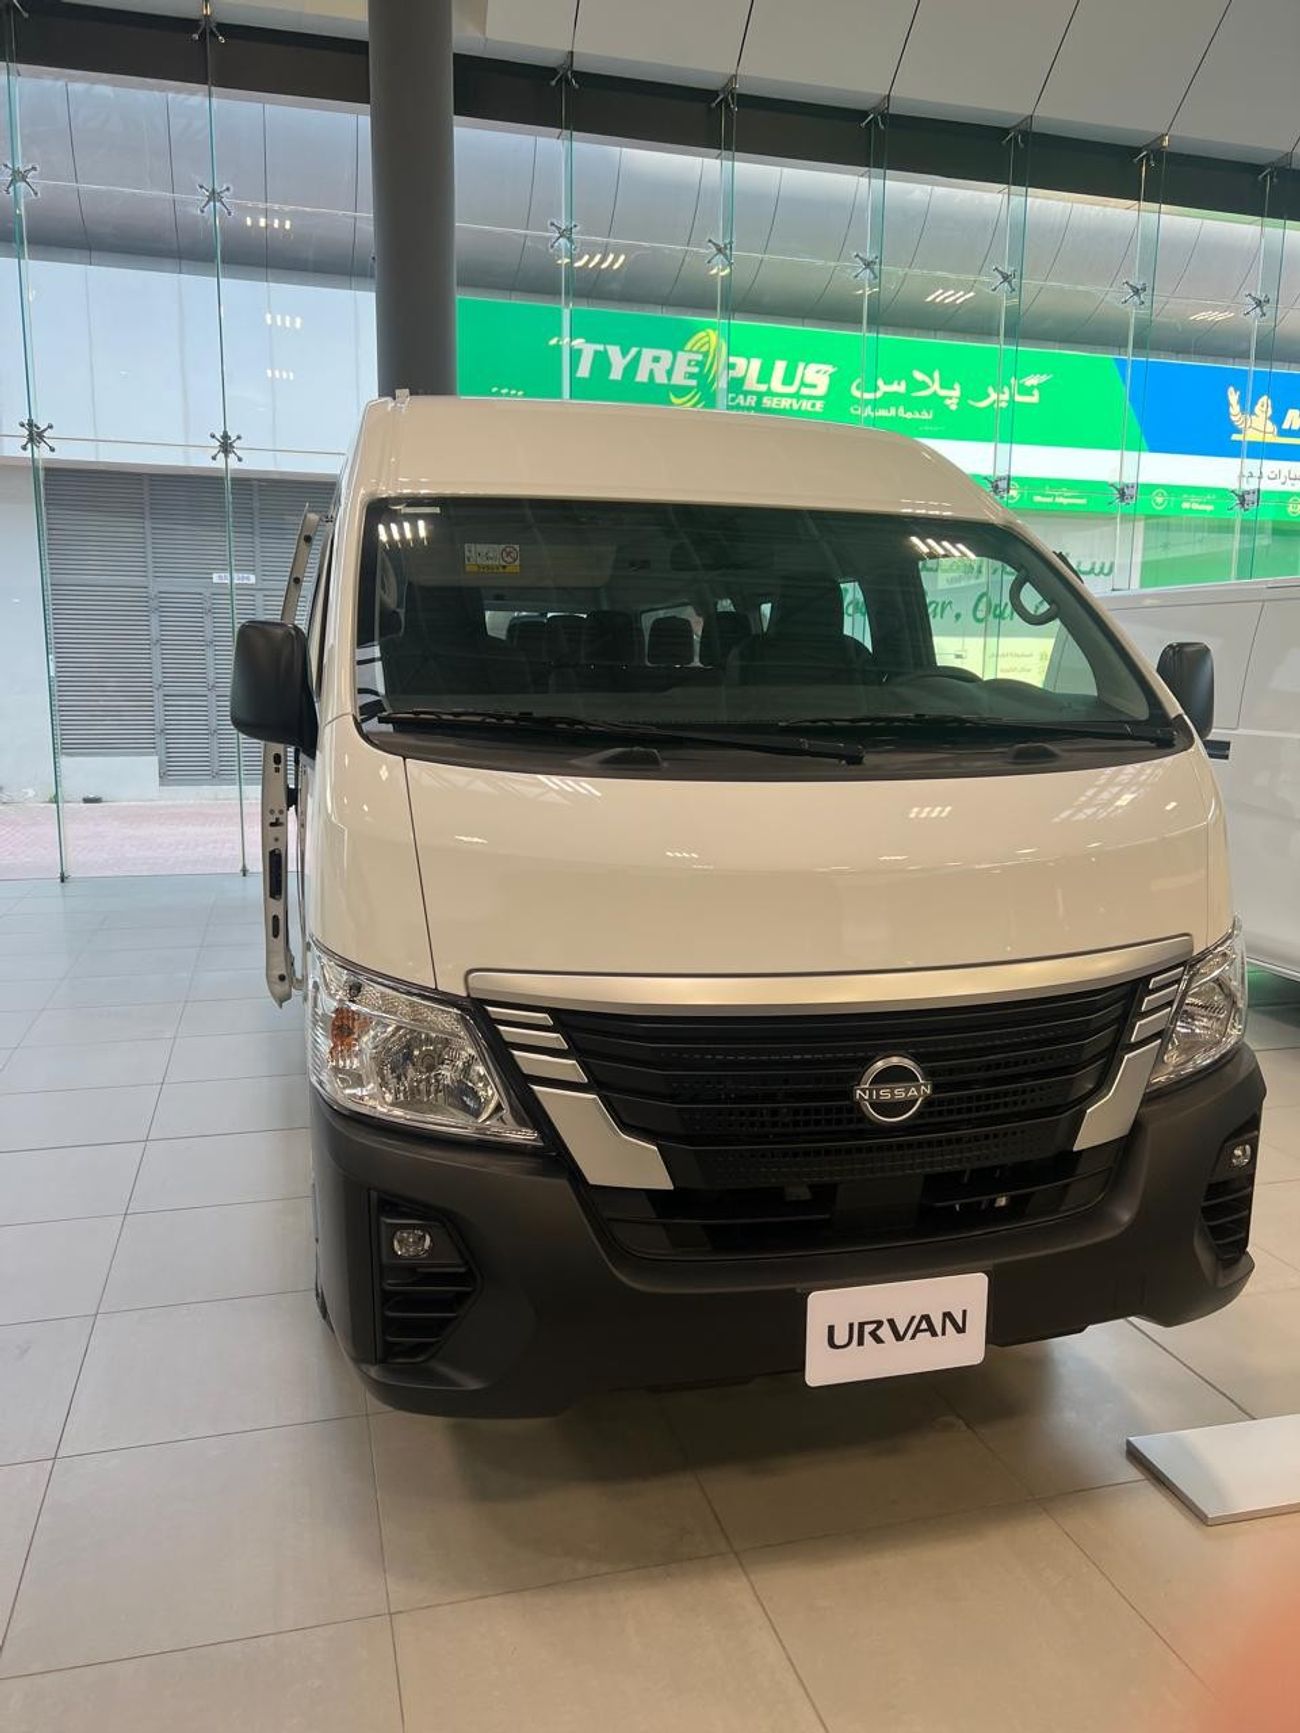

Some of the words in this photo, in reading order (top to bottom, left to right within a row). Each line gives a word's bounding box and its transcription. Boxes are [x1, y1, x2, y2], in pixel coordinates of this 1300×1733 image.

[573, 342, 703, 387] TYRE
[727, 355, 838, 397] PLUS
[728, 392, 756, 407] CAR
[761, 396, 825, 413] SERVICE
[927, 592, 962, 622] ar,
[855, 1084, 931, 1100] NISSAN
[827, 1309, 968, 1350] URVAN
